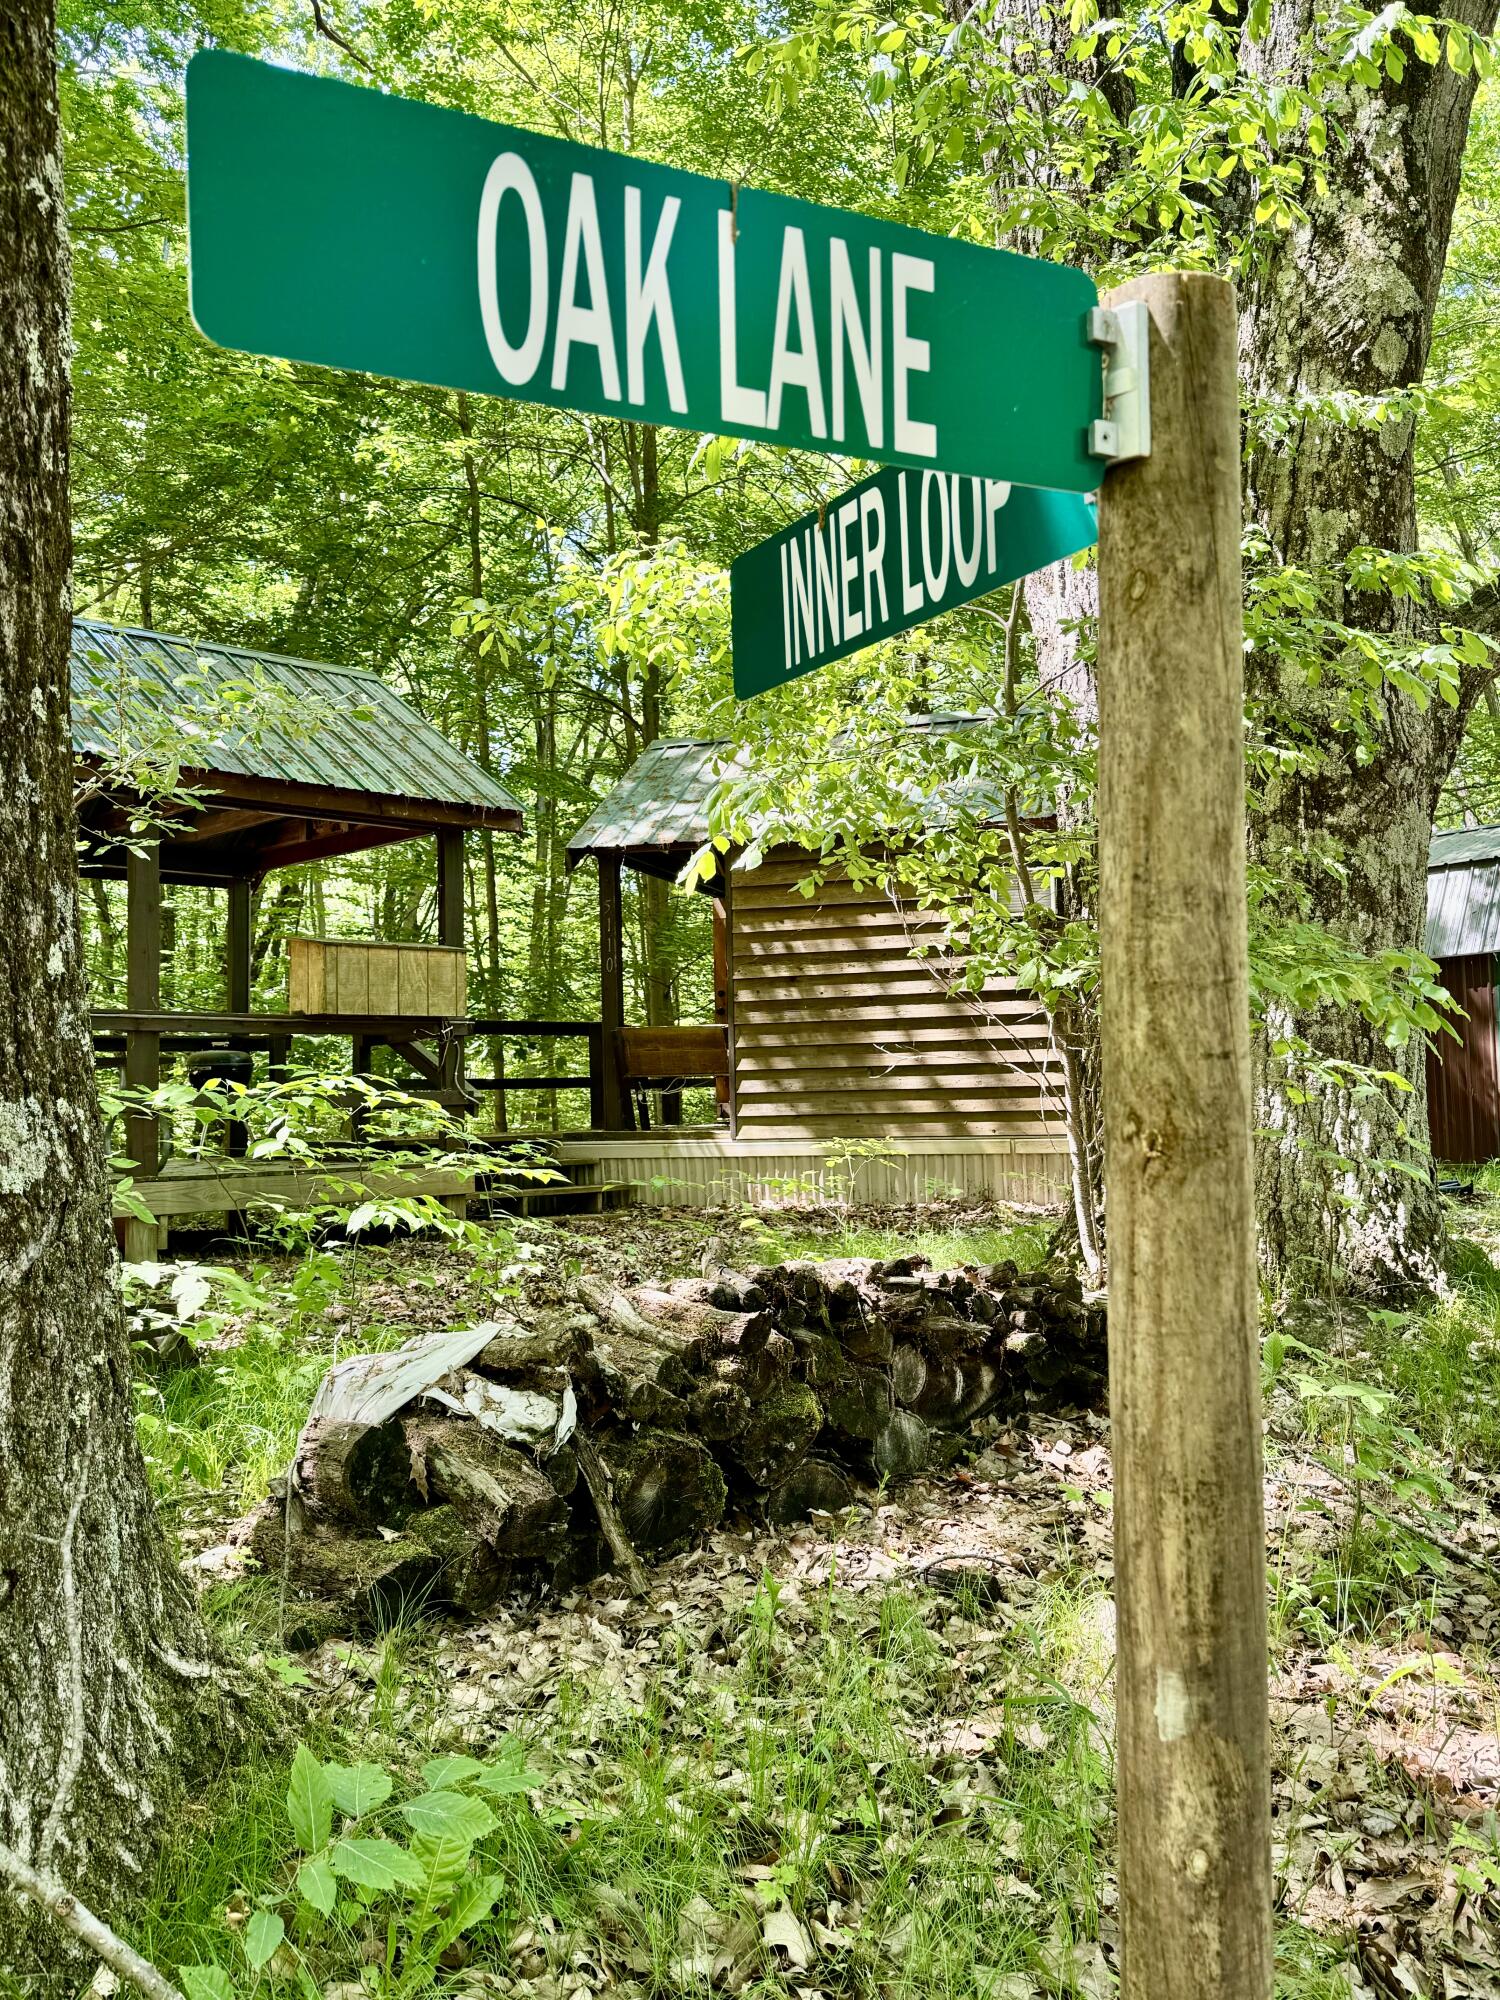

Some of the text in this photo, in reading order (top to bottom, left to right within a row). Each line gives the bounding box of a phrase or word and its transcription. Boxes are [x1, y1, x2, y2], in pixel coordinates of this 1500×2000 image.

[477, 152, 937, 458] OAK LANE
[780, 469, 1011, 670] INNER LOOP
